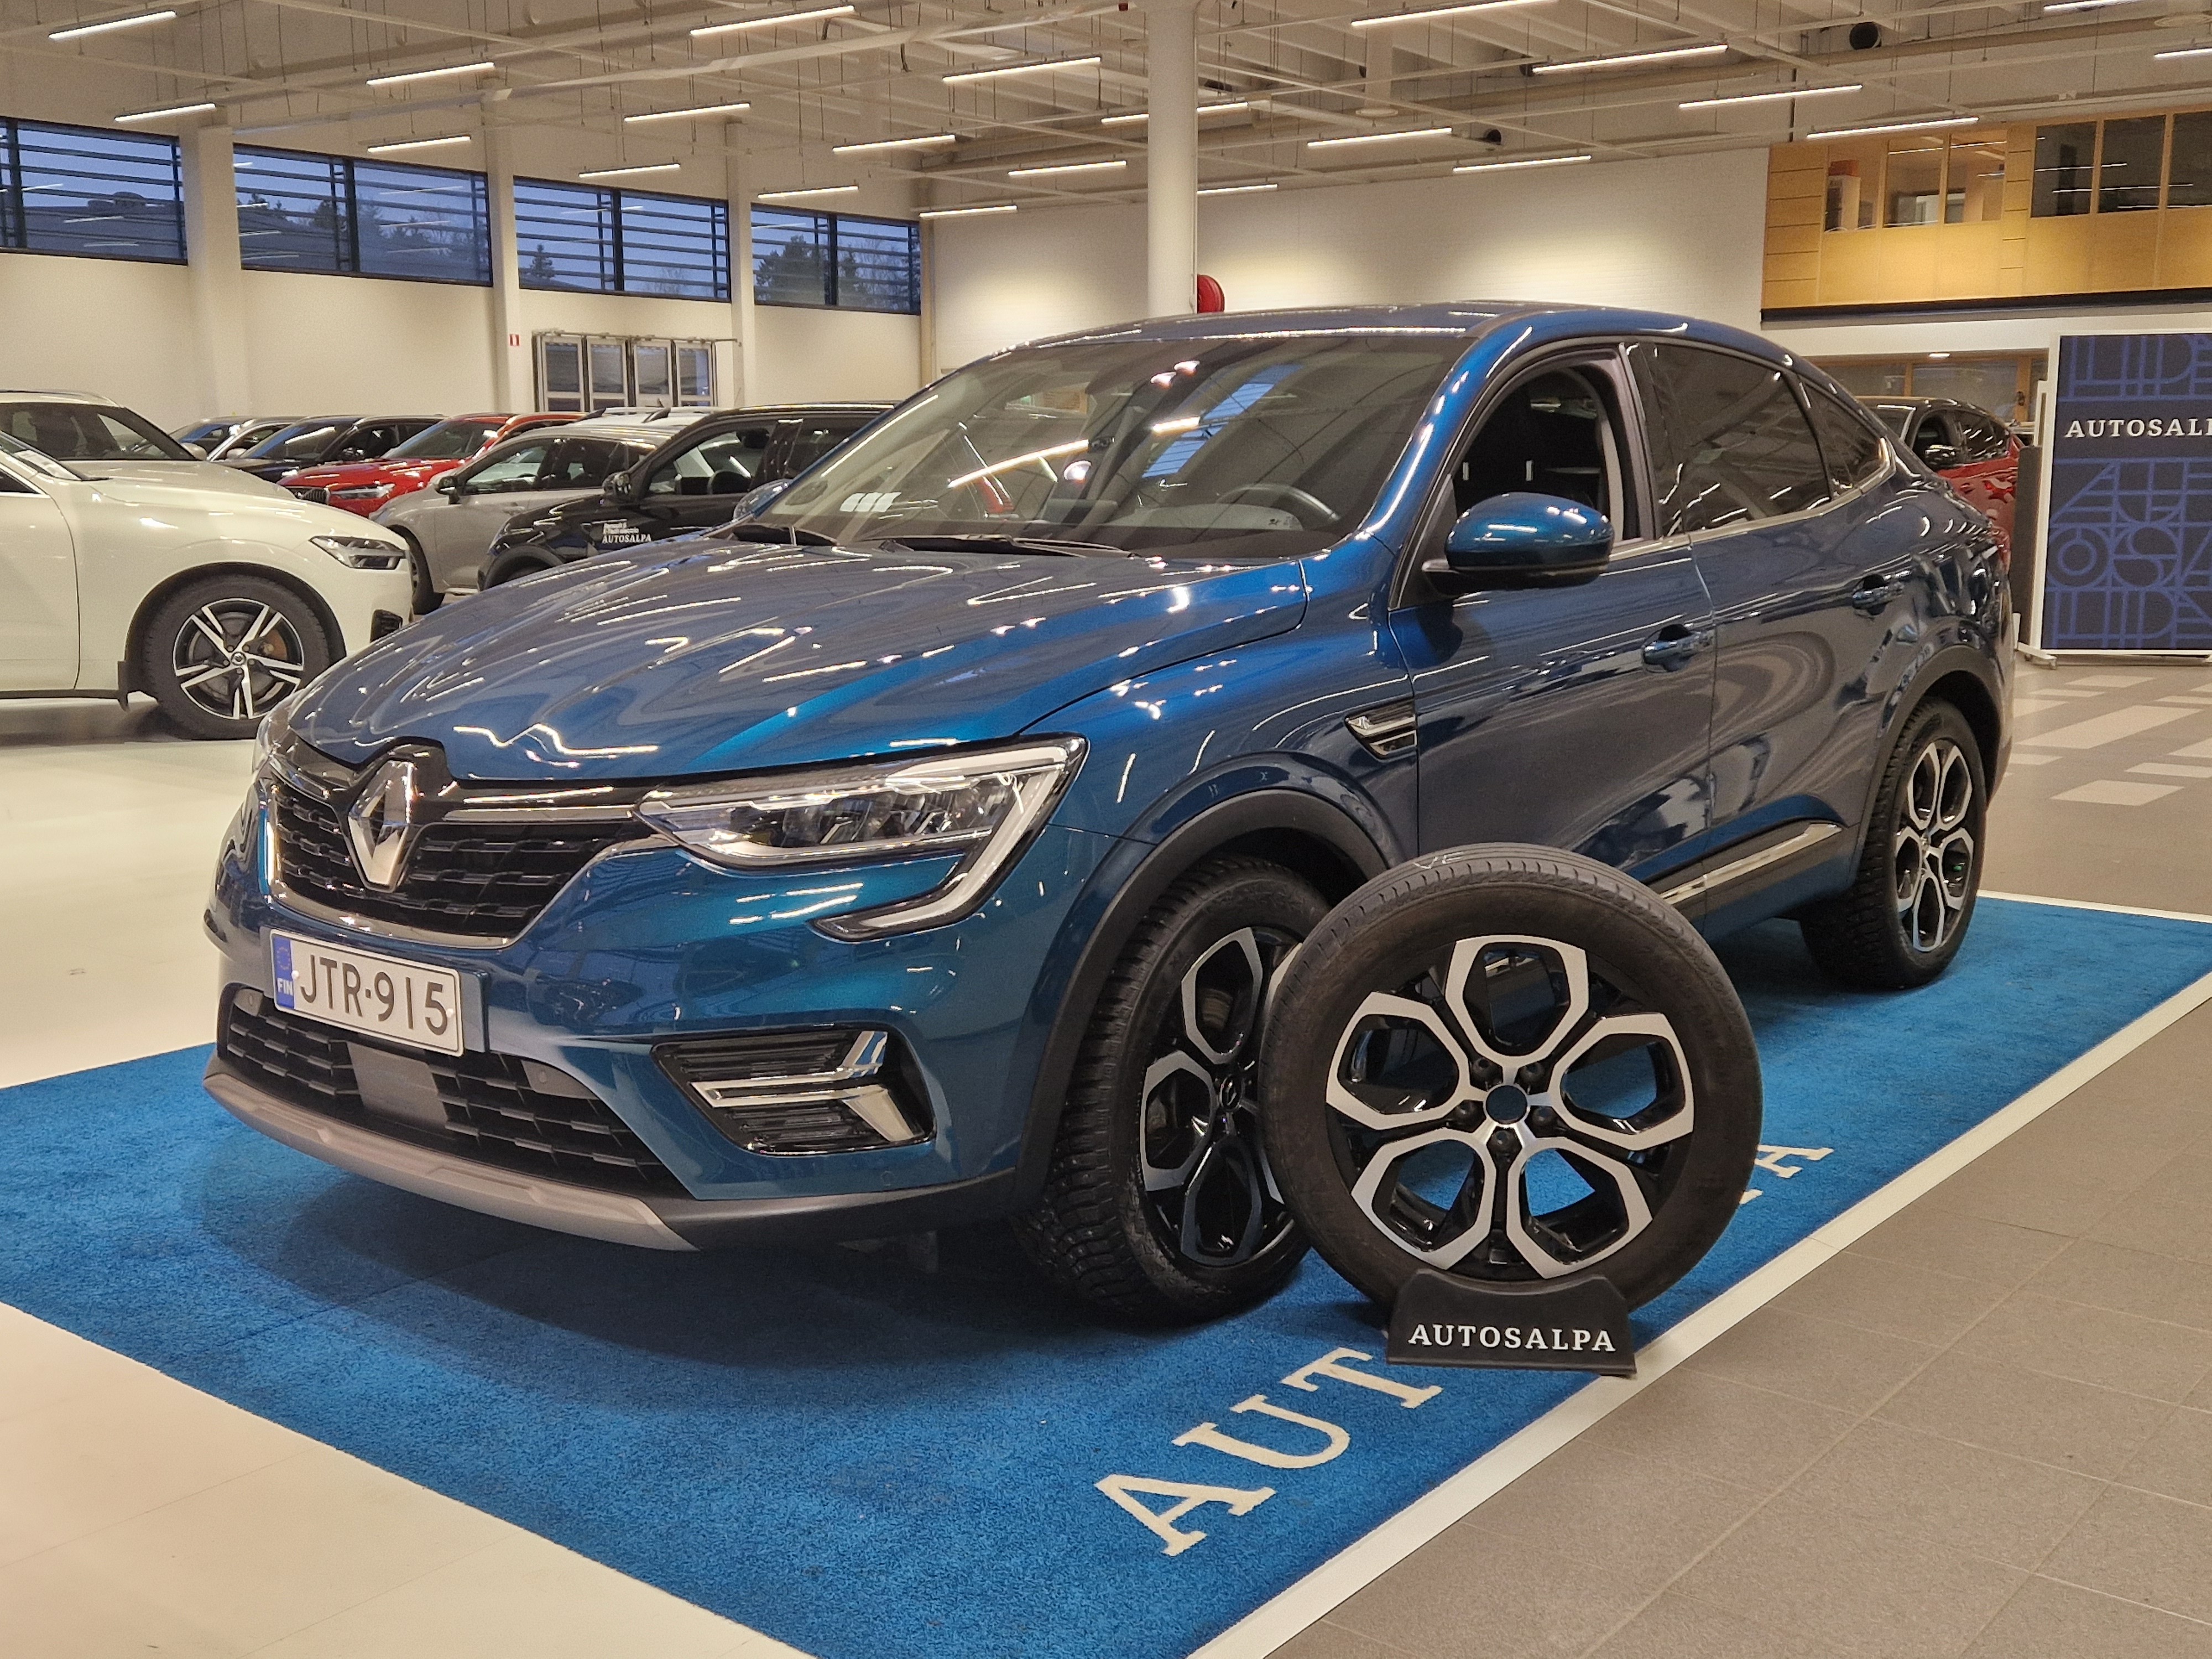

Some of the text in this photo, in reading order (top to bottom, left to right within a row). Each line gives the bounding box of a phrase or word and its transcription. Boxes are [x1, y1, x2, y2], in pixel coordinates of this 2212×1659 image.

[602, 534, 651, 544] AUTOSALPA
[276, 978, 293, 996] FIN
[300, 954, 448, 1035] JTR-915
[1408, 1324, 1616, 1352] AUTOSALPA
